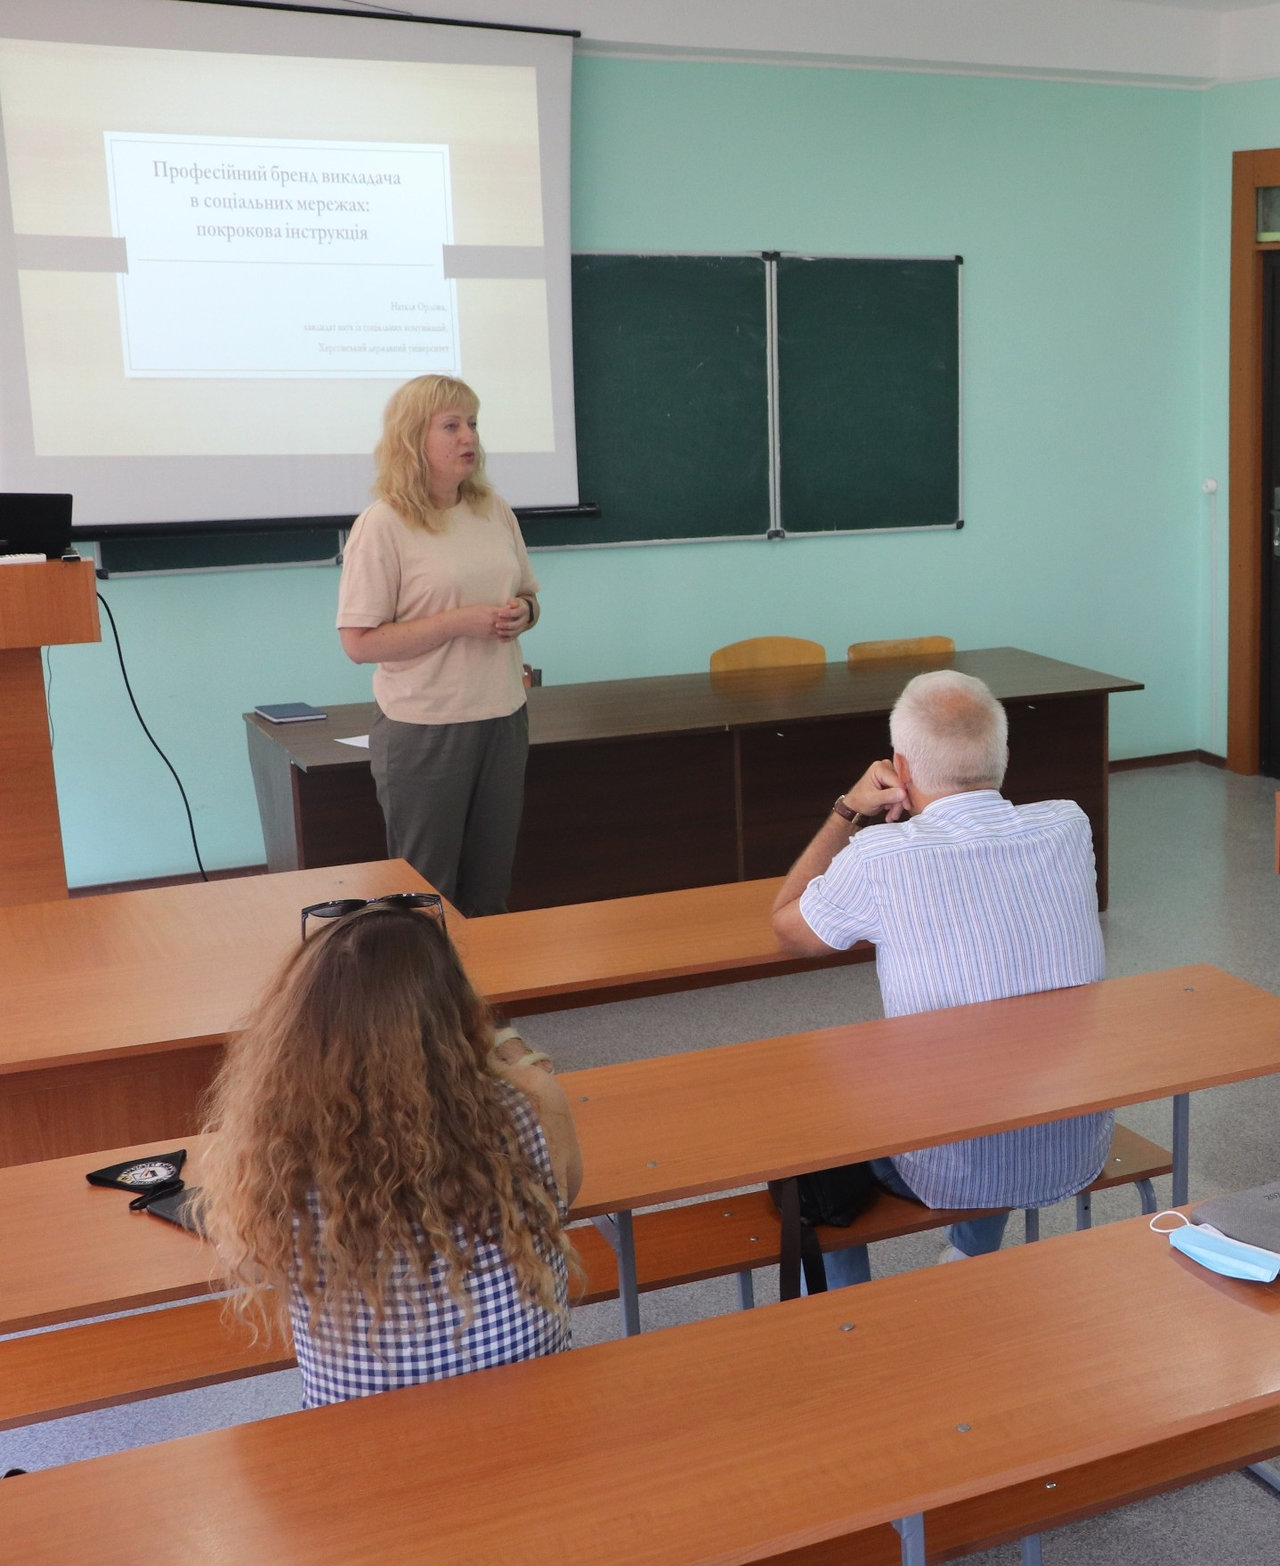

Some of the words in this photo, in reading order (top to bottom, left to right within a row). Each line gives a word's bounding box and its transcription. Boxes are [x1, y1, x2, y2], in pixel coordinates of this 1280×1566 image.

[152, 160, 267, 185] Професійний
[271, 165, 319, 188] бренд
[321, 171, 401, 186] викладача
[190, 196, 200, 208] в
[204, 192, 293, 211] соціальних
[297, 199, 370, 217] мережах:
[196, 224, 282, 243] покрокова
[286, 222, 368, 245] інструкція
